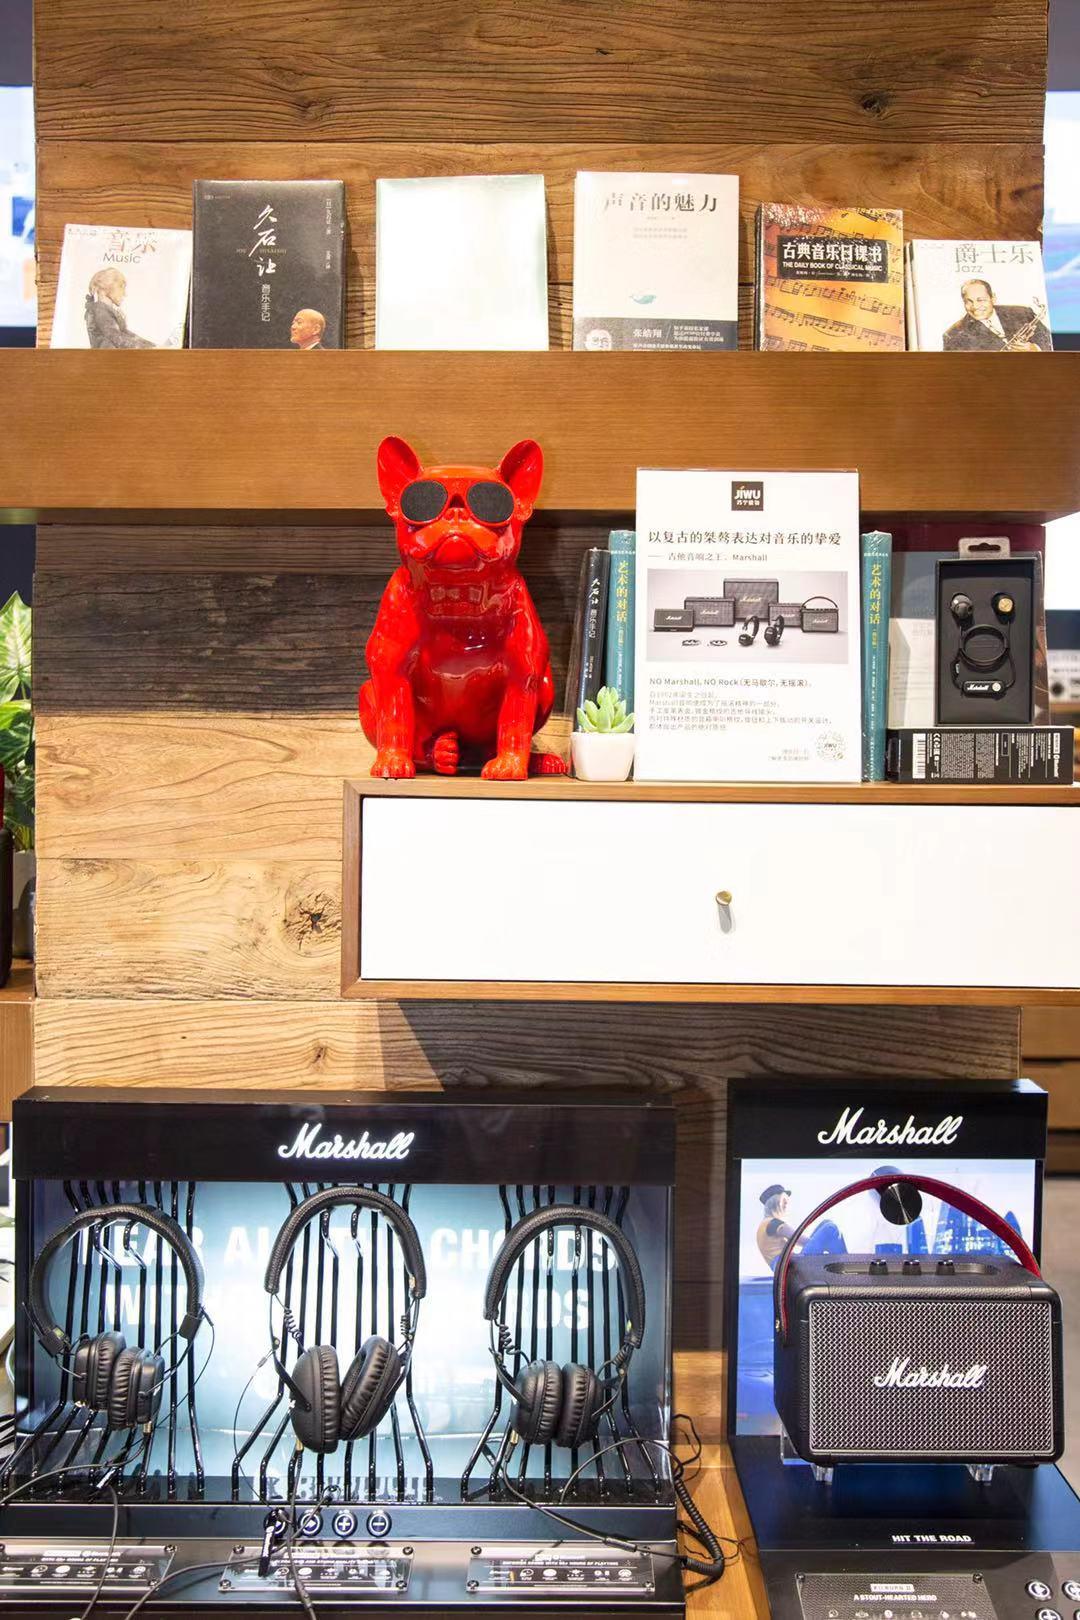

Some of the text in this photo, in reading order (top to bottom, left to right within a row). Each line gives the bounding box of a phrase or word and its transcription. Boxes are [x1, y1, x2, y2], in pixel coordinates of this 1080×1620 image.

[603, 192, 717, 212] 声音的魅力
[248, 204, 278, 277] 久石让
[782, 241, 882, 263] 古典音乐日课书
[954, 242, 1034, 265] 爵士乐
[102, 252, 142, 264] Music
[794, 261, 809, 269] DAILY
[834, 263, 864, 271] CLASSICAL
[864, 264, 883, 272] MUSIC
[261, 283, 271, 322] 音乐手记
[648, 531, 842, 546] 以复古的桀骜表达对音乐的挚爱
[732, 554, 768, 562] Marshall
[616, 560, 629, 623] 艺术的对话
[869, 563, 882, 625] 艺术的对话
[649, 678, 662, 686] NO
[818, 1106, 964, 1145] Marshall
[277, 1122, 416, 1160] Marshall
[429, 1227, 618, 1271] CHRDS
[873, 1356, 988, 1388] Marshall
